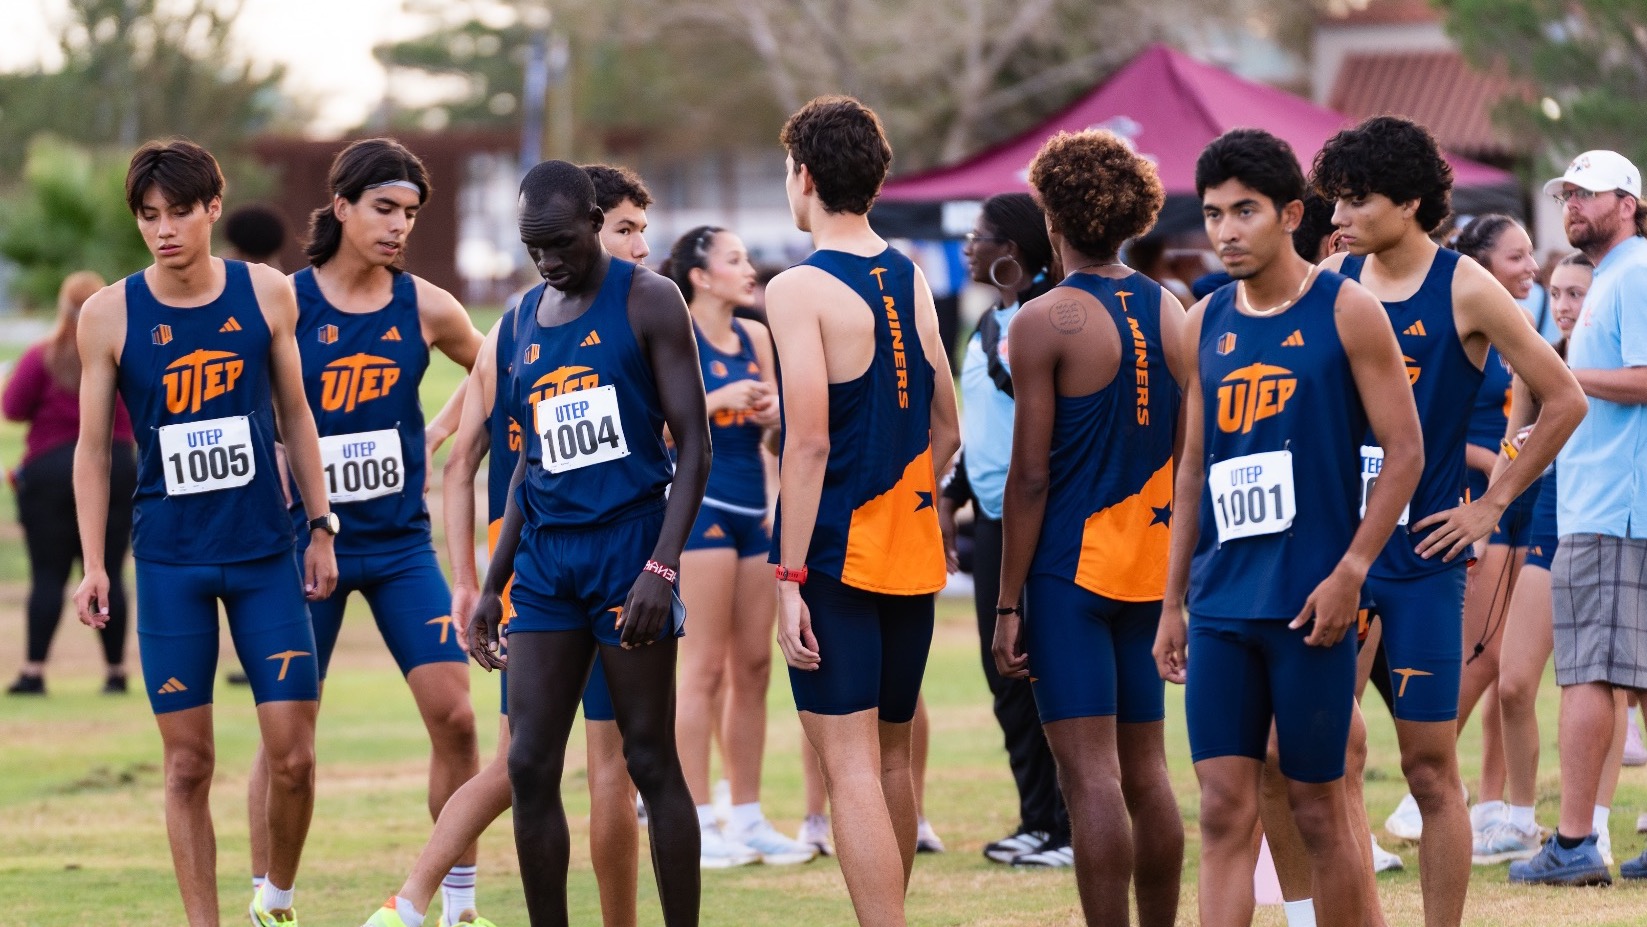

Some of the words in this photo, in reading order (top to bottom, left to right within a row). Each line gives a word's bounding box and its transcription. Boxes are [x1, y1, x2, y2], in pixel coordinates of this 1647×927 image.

[882, 295, 909, 409] MINERS
[1126, 316, 1150, 426] MINERS
[162, 348, 245, 414] UTEP
[320, 352, 401, 413] UTEP
[1217, 362, 1298, 435] UTEP
[555, 400, 590, 423] UTEP
[187, 428, 223, 448] UTEP
[342, 441, 376, 459] UTEP
[543, 415, 620, 464] 1004
[168, 443, 250, 484] 1005
[324, 456, 400, 494] 1008
[1230, 465, 1263, 487] UTEP
[1360, 456, 1384, 474] TEP
[1217, 483, 1284, 529] 1001
